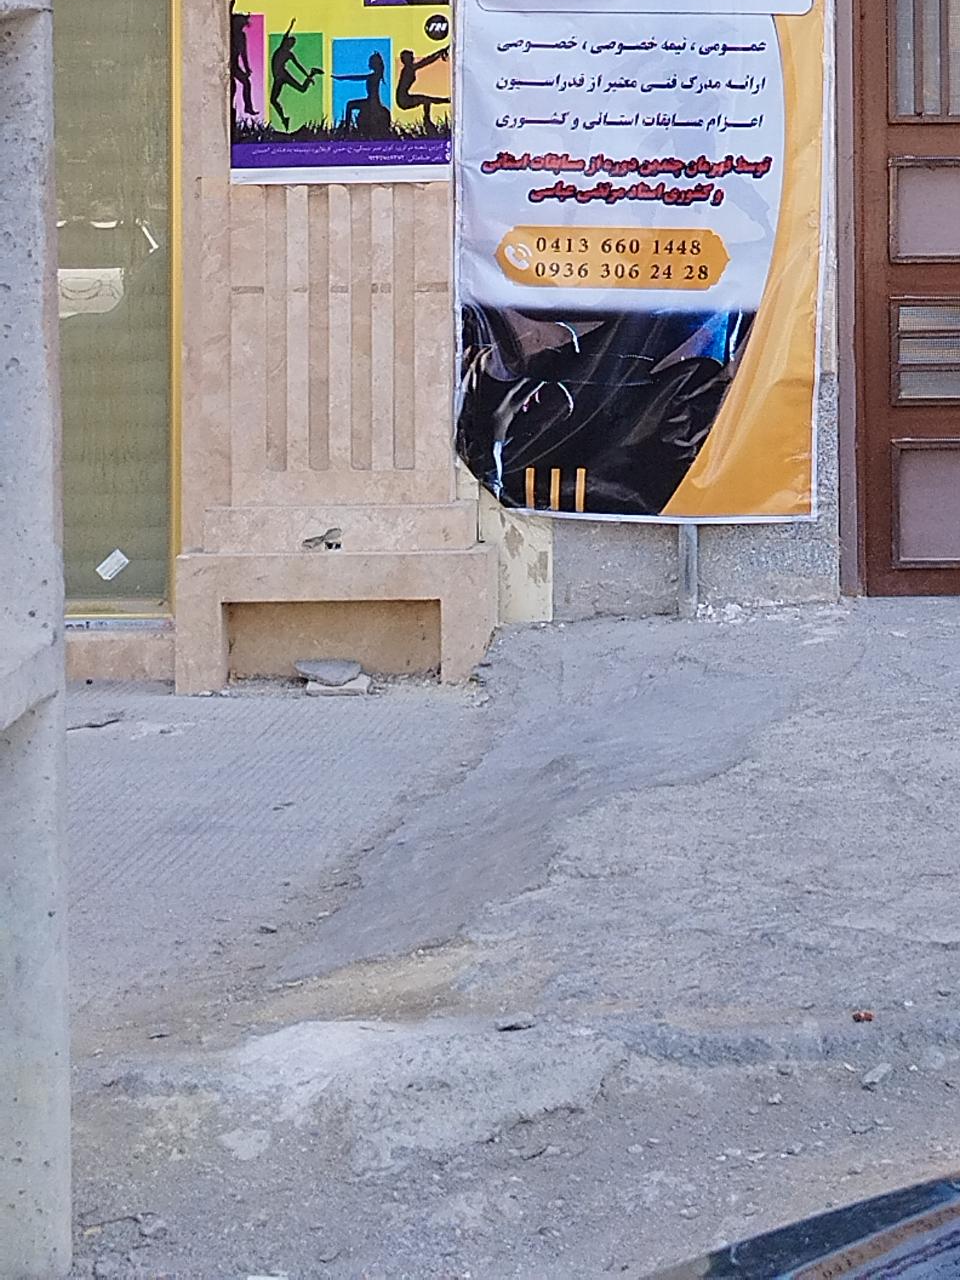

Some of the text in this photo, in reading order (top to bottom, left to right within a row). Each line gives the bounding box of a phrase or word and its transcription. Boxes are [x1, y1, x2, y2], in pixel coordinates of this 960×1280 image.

[497, 35, 578, 53] خصوصی
[661, 36, 687, 56] نیمه
[495, 73, 584, 93] فدراسیون
[587, 74, 603, 93] از
[603, 76, 638, 95] معتبر
[640, 73, 678, 93] فنی
[681, 75, 720, 95] مدرک
[495, 111, 570, 129] کشوری
[571, 116, 579, 131] و
[583, 111, 639, 130] استانی
[706, 113, 764, 132] اعزام
[528, 180, 577, 203] عباسی
[710, 188, 724, 207] و
[536, 237, 702, 256] 0413 660 1448
[535, 261, 709, 281] 0936 306 24 28
